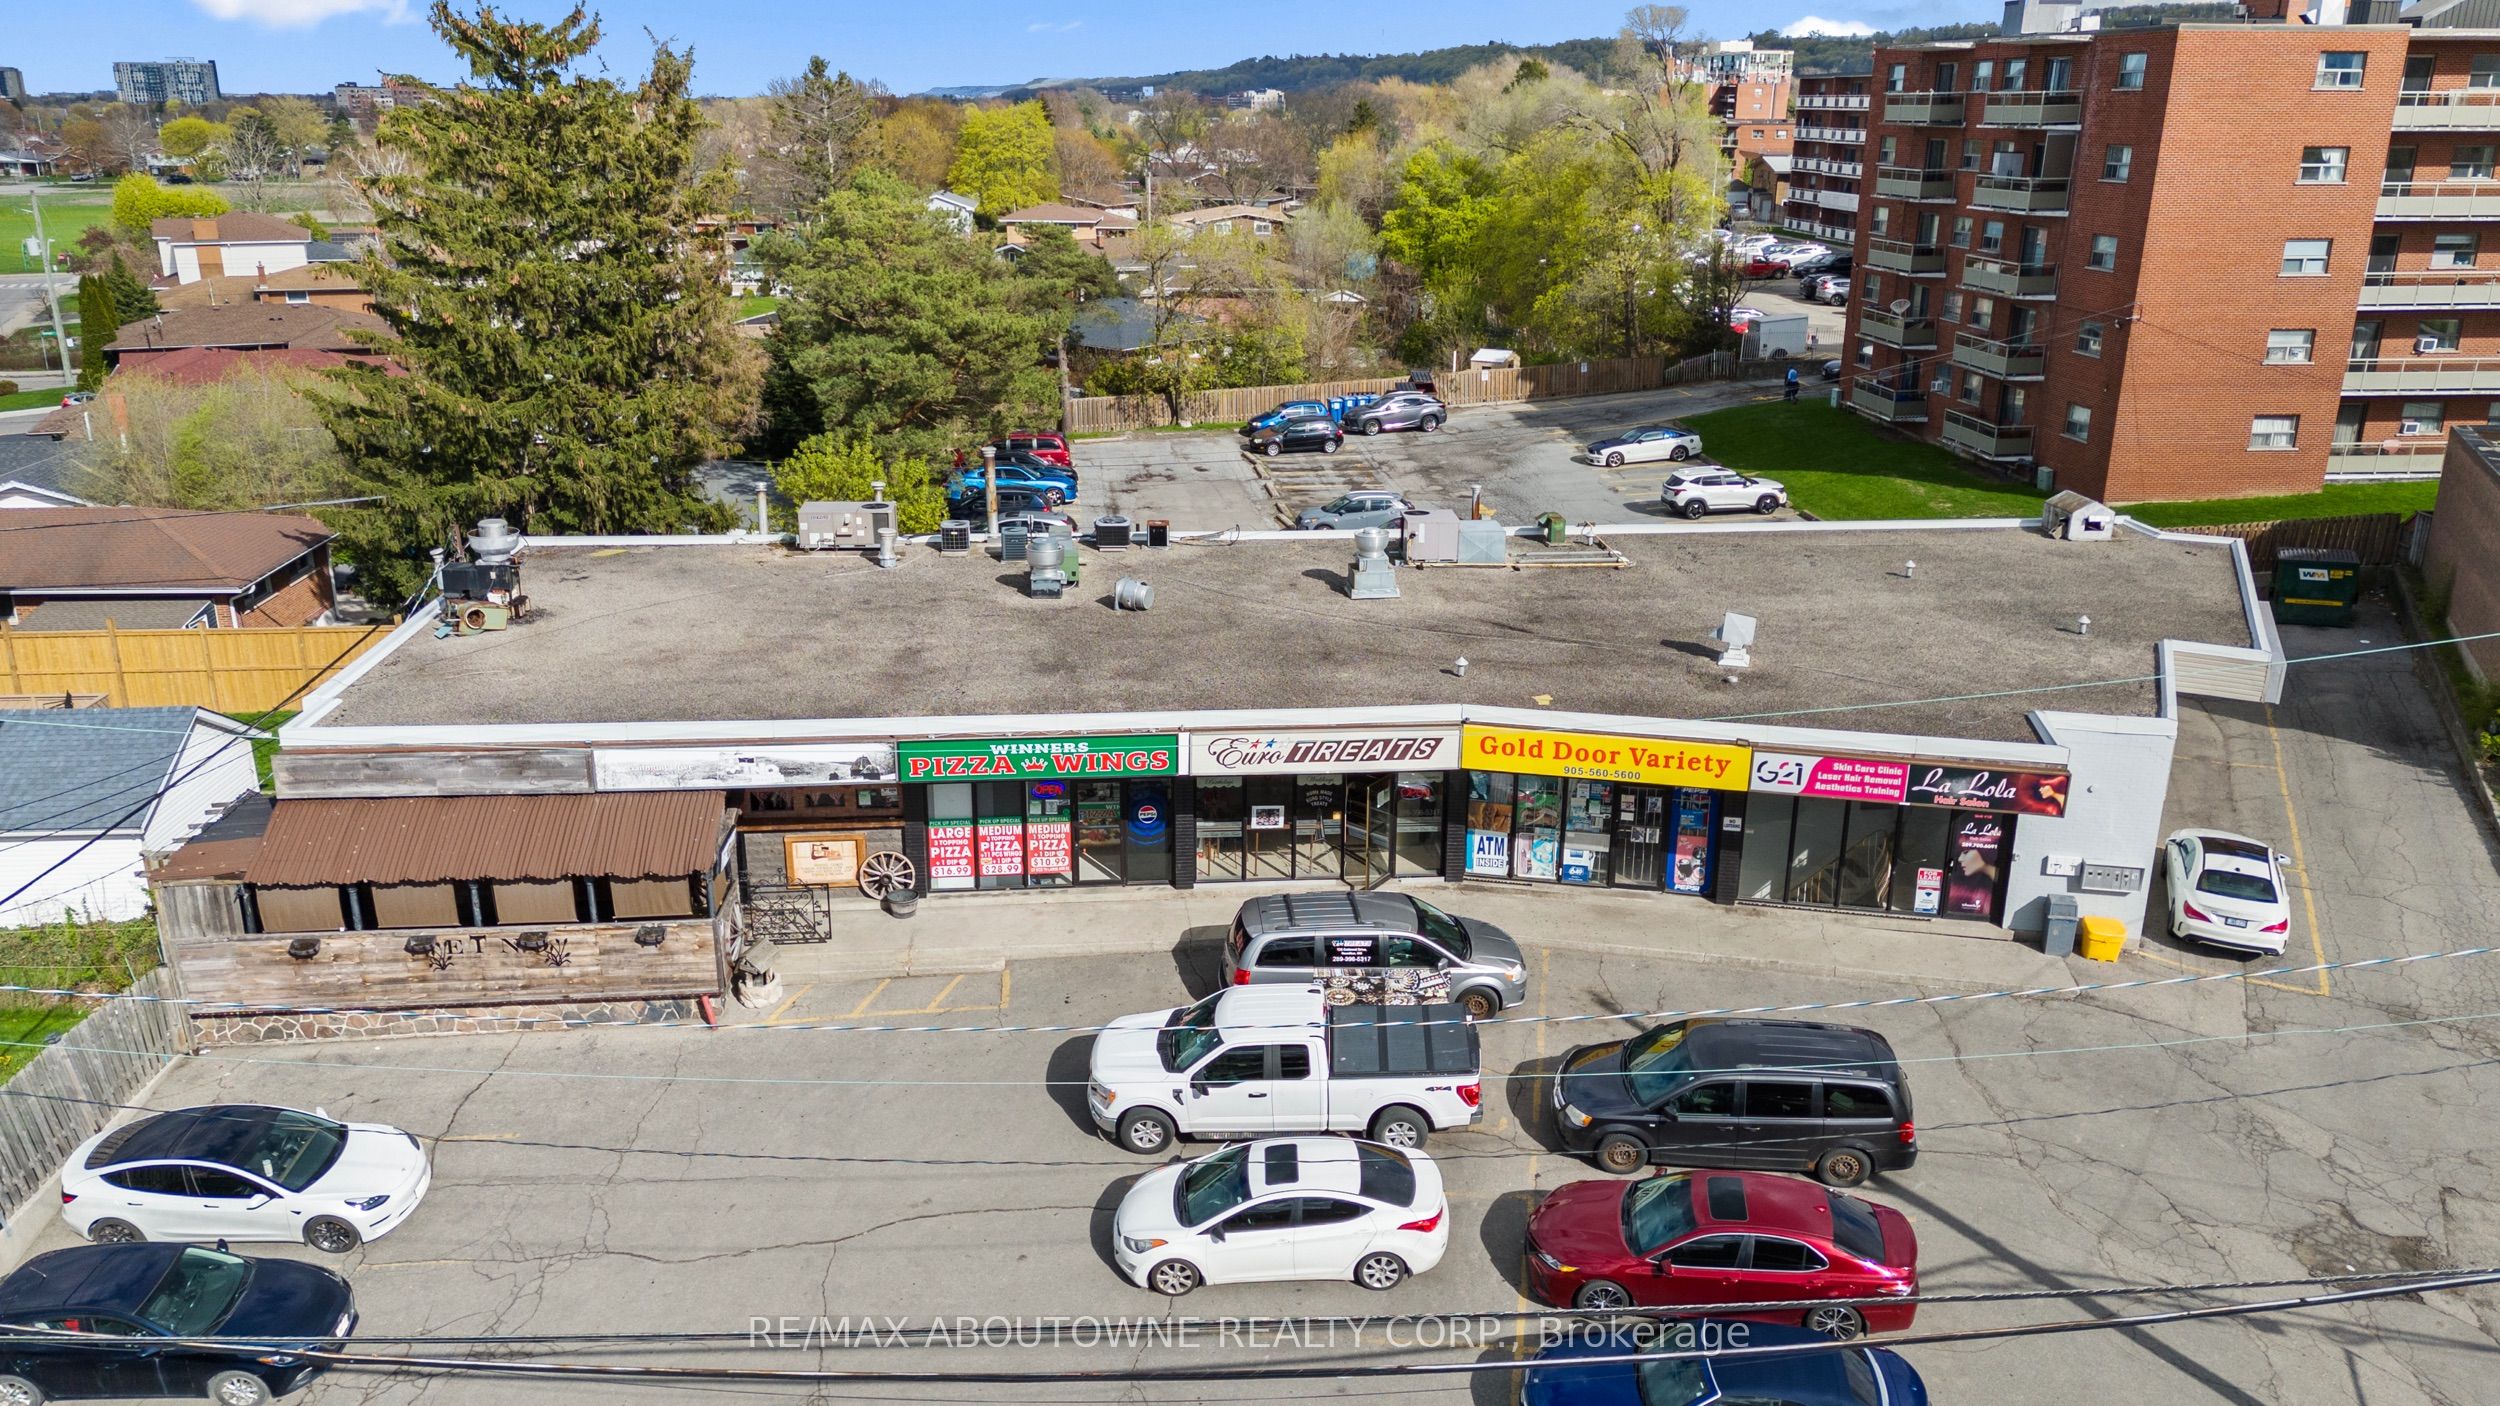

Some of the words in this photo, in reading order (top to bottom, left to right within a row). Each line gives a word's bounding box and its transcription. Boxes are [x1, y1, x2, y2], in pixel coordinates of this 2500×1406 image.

[990, 742, 1089, 755] WINNERS
[1207, 737, 1285, 769] Euro
[1288, 738, 1440, 763] TREATS
[908, 755, 1016, 777] PIZZA
[1051, 750, 1170, 773] WINGS
[1479, 736, 1544, 760] Gold
[1552, 741, 1621, 765] Door
[1629, 747, 1732, 779] Variety
[1563, 766, 1641, 780] 905-560-5600
[1833, 762, 1852, 772] Skin
[1854, 764, 1875, 773] Care
[1877, 766, 1903, 775] Clinic
[1817, 772, 1841, 780] Laser
[1844, 773, 1862, 782] Hair
[1863, 775, 1902, 785] Removal
[1911, 768, 1952, 795] La
[1957, 772, 2016, 799] Lola
[1036, 784, 1063, 794] OPEN
[1814, 782, 1862, 793] Aesthetics
[1864, 786, 1901, 798] Training
[1933, 794, 1958, 806] Hair
[1959, 797, 1990, 808] Salon
[930, 827, 971, 839] LARGE
[979, 825, 1022, 836] MEDIUM
[1028, 824, 1070, 834] MEDIUM
[1960, 822, 1978, 834] La
[1978, 823, 2002, 836] Lola
[980, 841, 1022, 852] PIZZA
[1030, 839, 1069, 851] PIZZA
[1477, 836, 1505, 857] ATM
[930, 846, 972, 858] PIZZA
[1033, 857, 1067, 866] $10.99
[1476, 857, 1504, 868] INSIDE
[934, 866, 969, 876] $16.99
[985, 864, 1019, 874] $28.99
